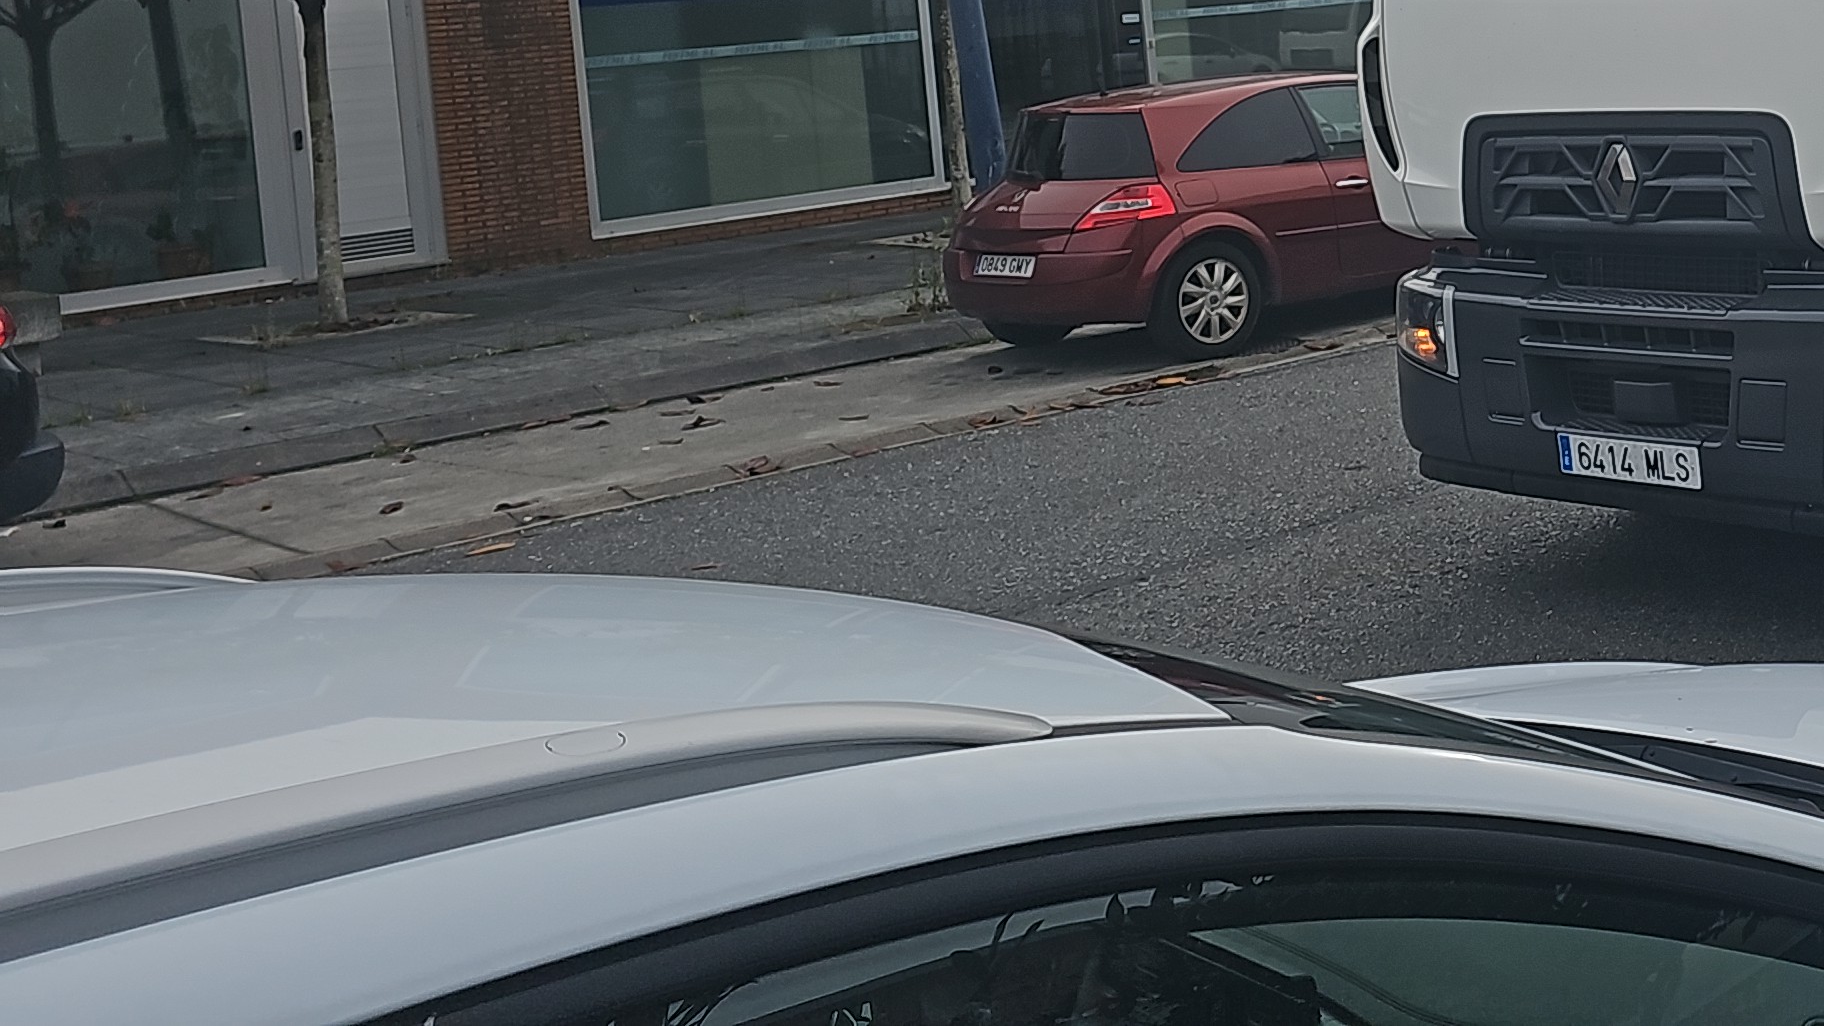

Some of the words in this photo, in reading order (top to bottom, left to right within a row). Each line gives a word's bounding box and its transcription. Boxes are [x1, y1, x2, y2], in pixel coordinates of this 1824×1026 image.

[981, 256, 1007, 273] 0849
[1577, 441, 1634, 476] 6414
[1643, 448, 1690, 483] MLS
